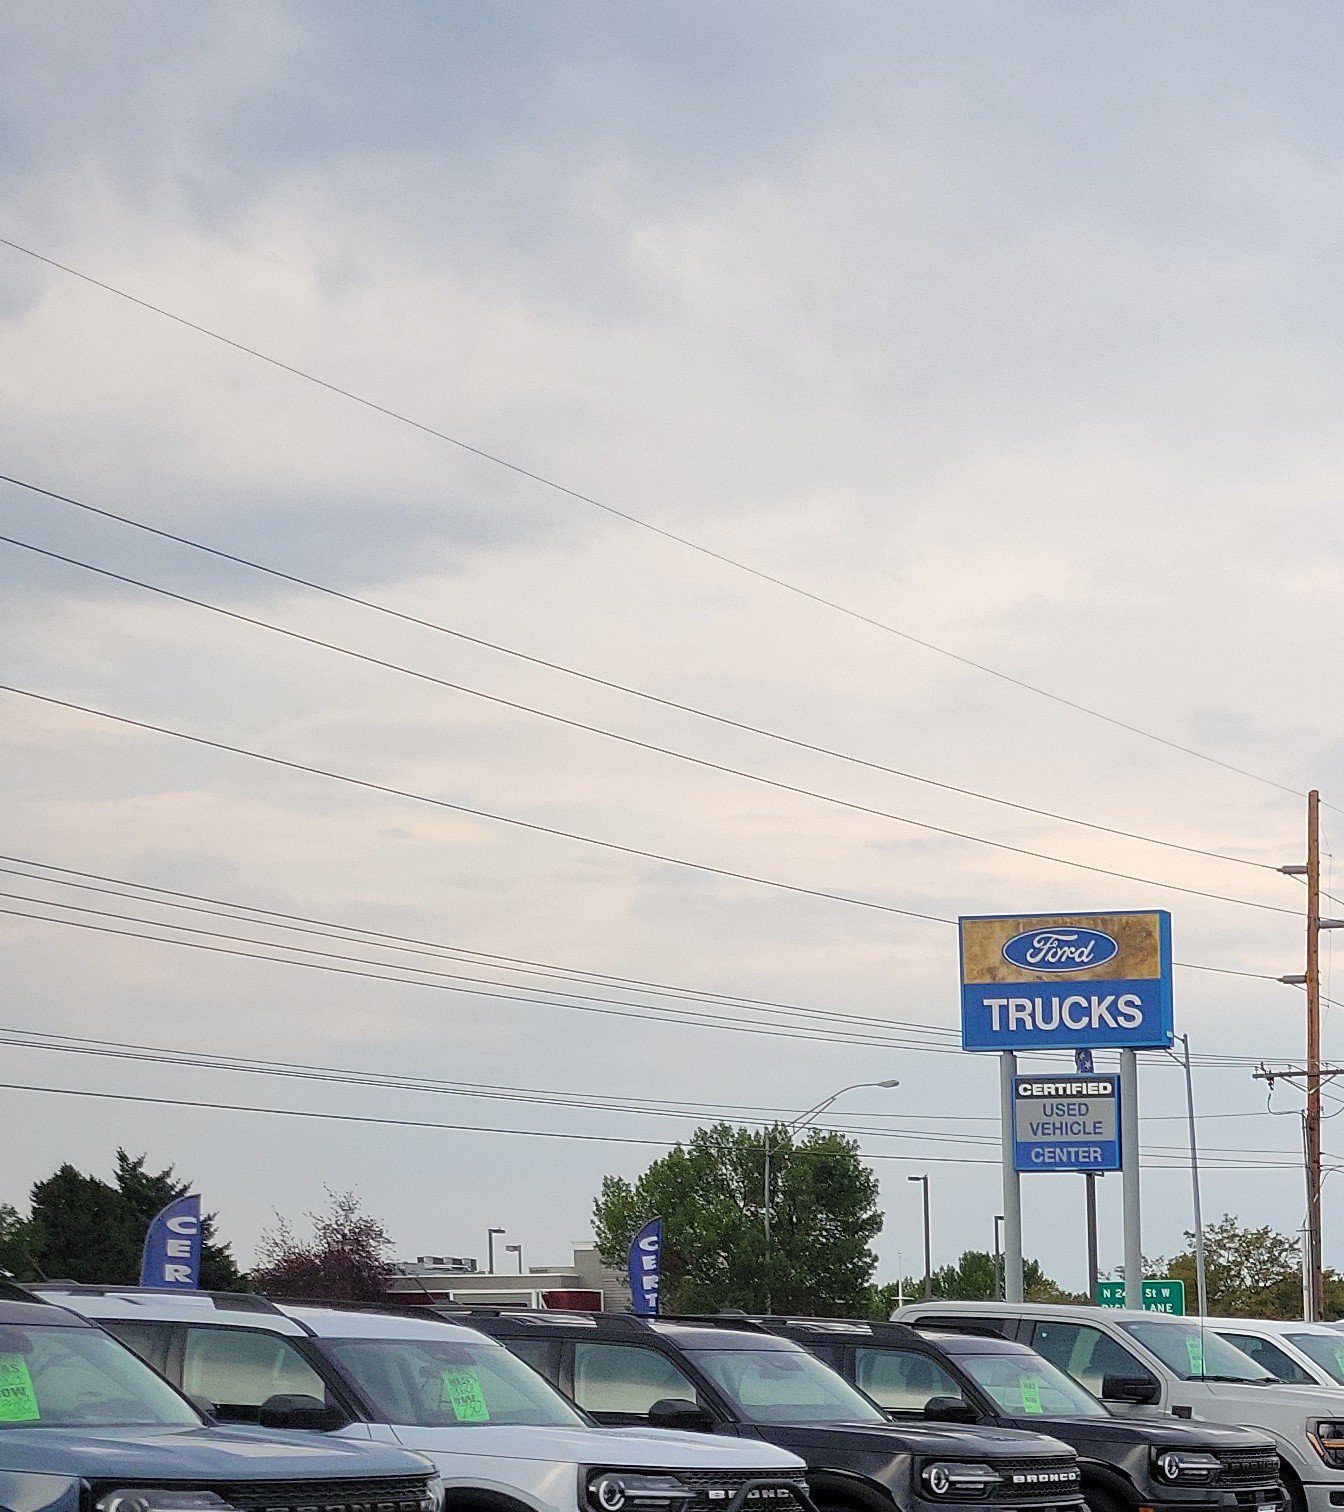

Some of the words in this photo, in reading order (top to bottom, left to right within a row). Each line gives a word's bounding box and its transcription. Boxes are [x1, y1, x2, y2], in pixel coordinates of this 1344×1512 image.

[1026, 933, 1096, 963] Ford
[982, 993, 1143, 1031] TRUCKS
[1018, 1082, 1112, 1096] CERTIFIED
[1042, 1102, 1089, 1117] USED
[1029, 1120, 1103, 1136] VEHICLE
[1031, 1147, 1102, 1162] CENTER
[1103, 1288, 1111, 1298] N
[1145, 1288, 1157, 1298] St
[1161, 1287, 1170, 1298] W
[1013, 1472, 1076, 1483] BRONCO
[709, 1489, 793, 1499] BRONC
